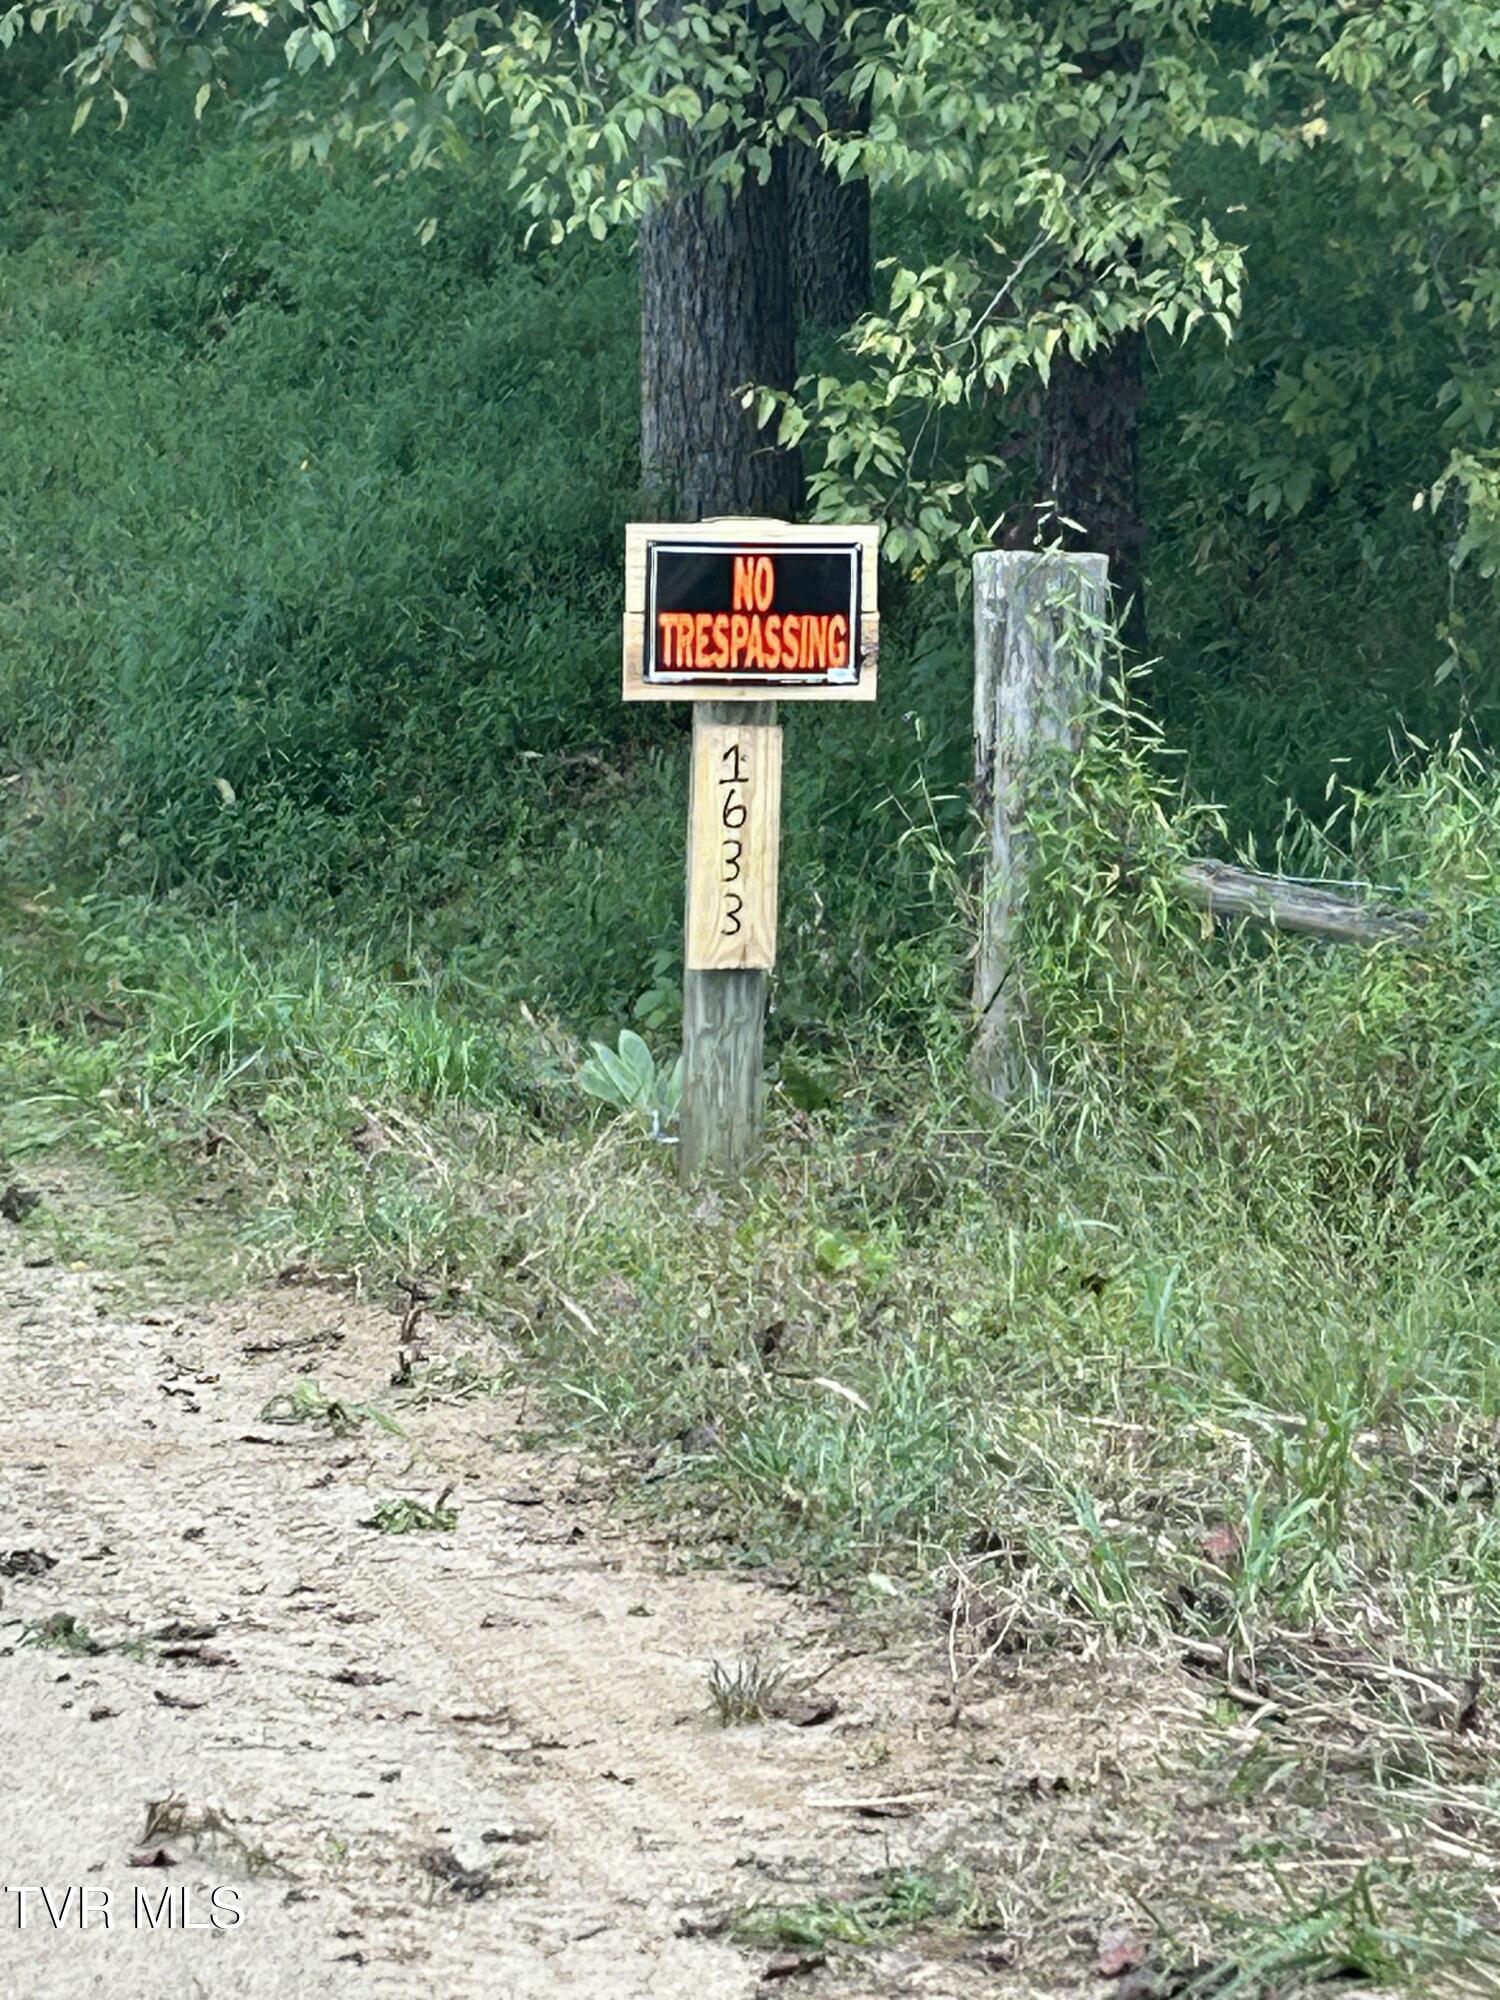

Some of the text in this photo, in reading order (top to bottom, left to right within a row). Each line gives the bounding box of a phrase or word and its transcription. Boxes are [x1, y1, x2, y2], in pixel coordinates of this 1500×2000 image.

[732, 556, 774, 612] NO
[659, 613, 846, 669] TRESPASSING
[719, 744, 749, 936] 1633
